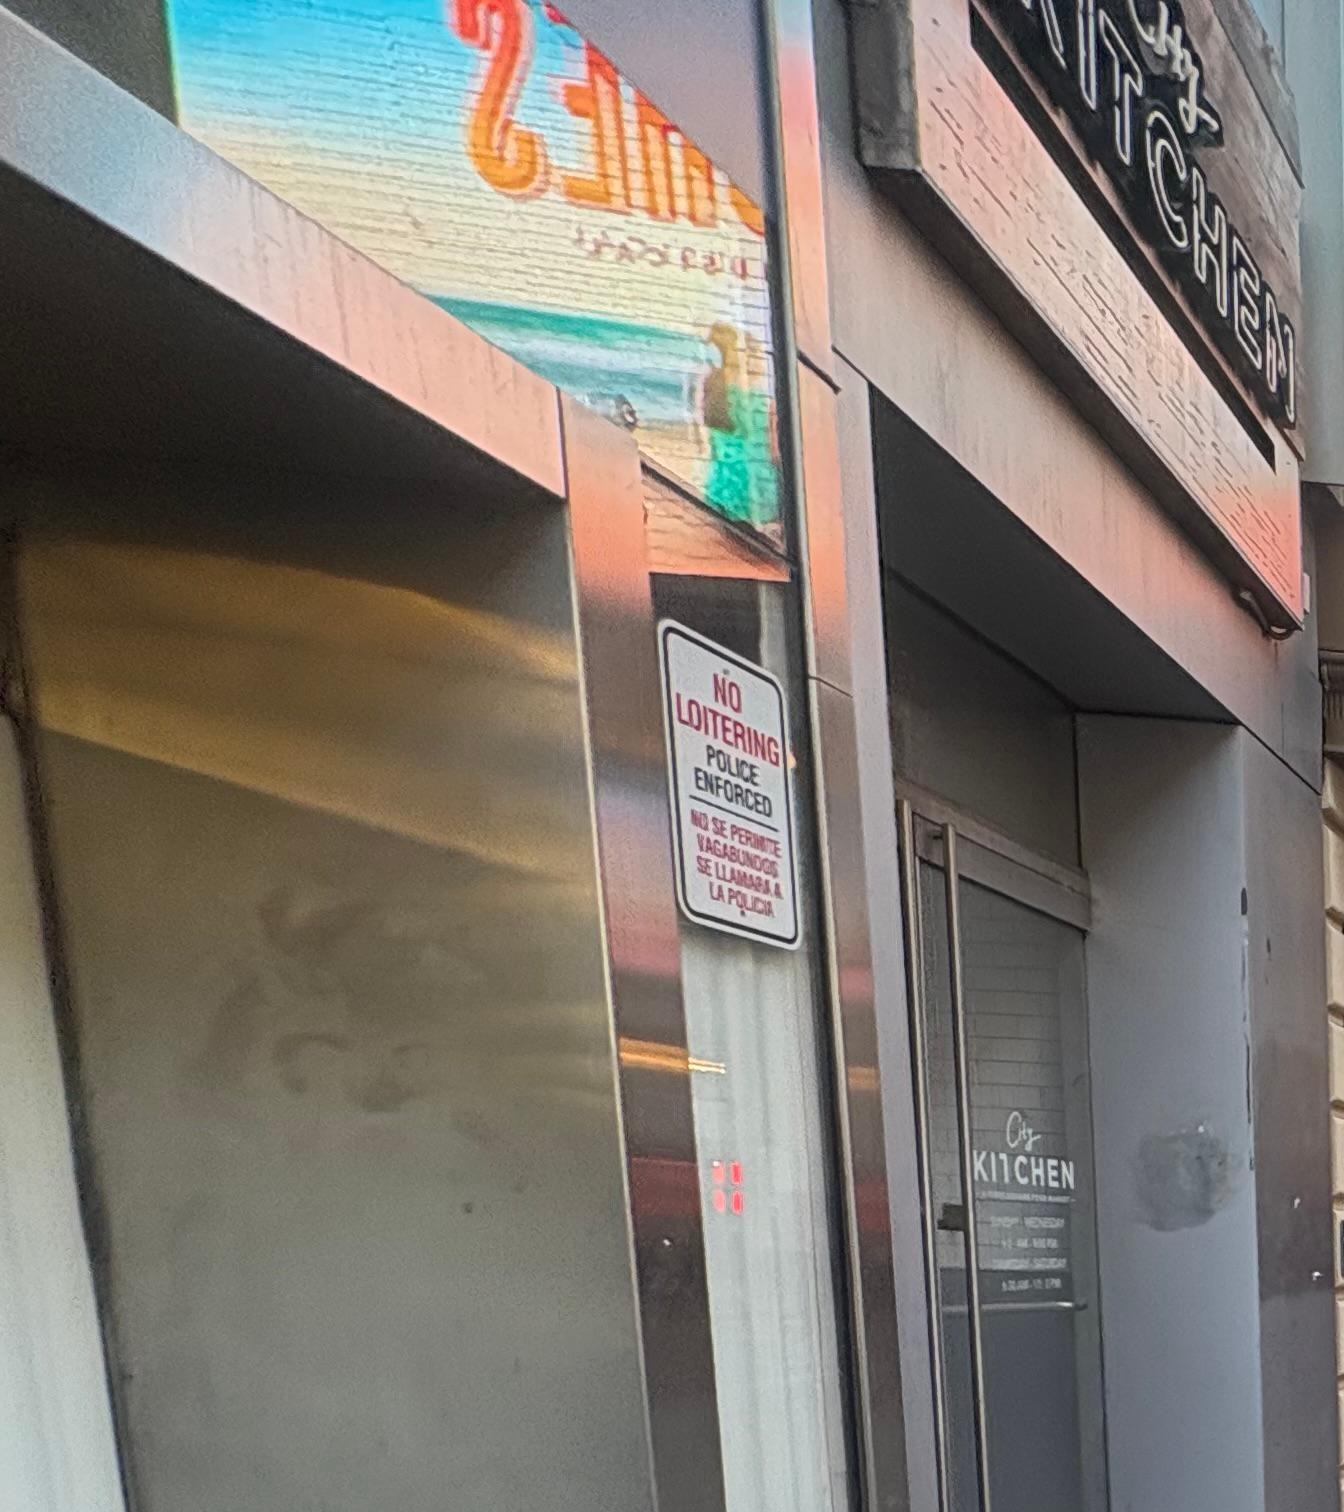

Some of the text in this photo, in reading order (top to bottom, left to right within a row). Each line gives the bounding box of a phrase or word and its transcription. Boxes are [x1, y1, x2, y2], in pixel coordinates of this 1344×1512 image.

[713, 672, 742, 714] NO
[675, 691, 780, 767] LOITERING
[706, 744, 761, 787] POLICE
[694, 766, 773, 819] ENFORCED
[690, 808, 782, 858] NO SE PERMITE
[697, 832, 779, 879] VAGABUNDOS
[697, 854, 712, 876] SE
[773, 881, 784, 900] A
[709, 881, 775, 918] LA POLICIA
[1006, 1111, 1043, 1152] City
[972, 1149, 1075, 1190] KITCHEN
